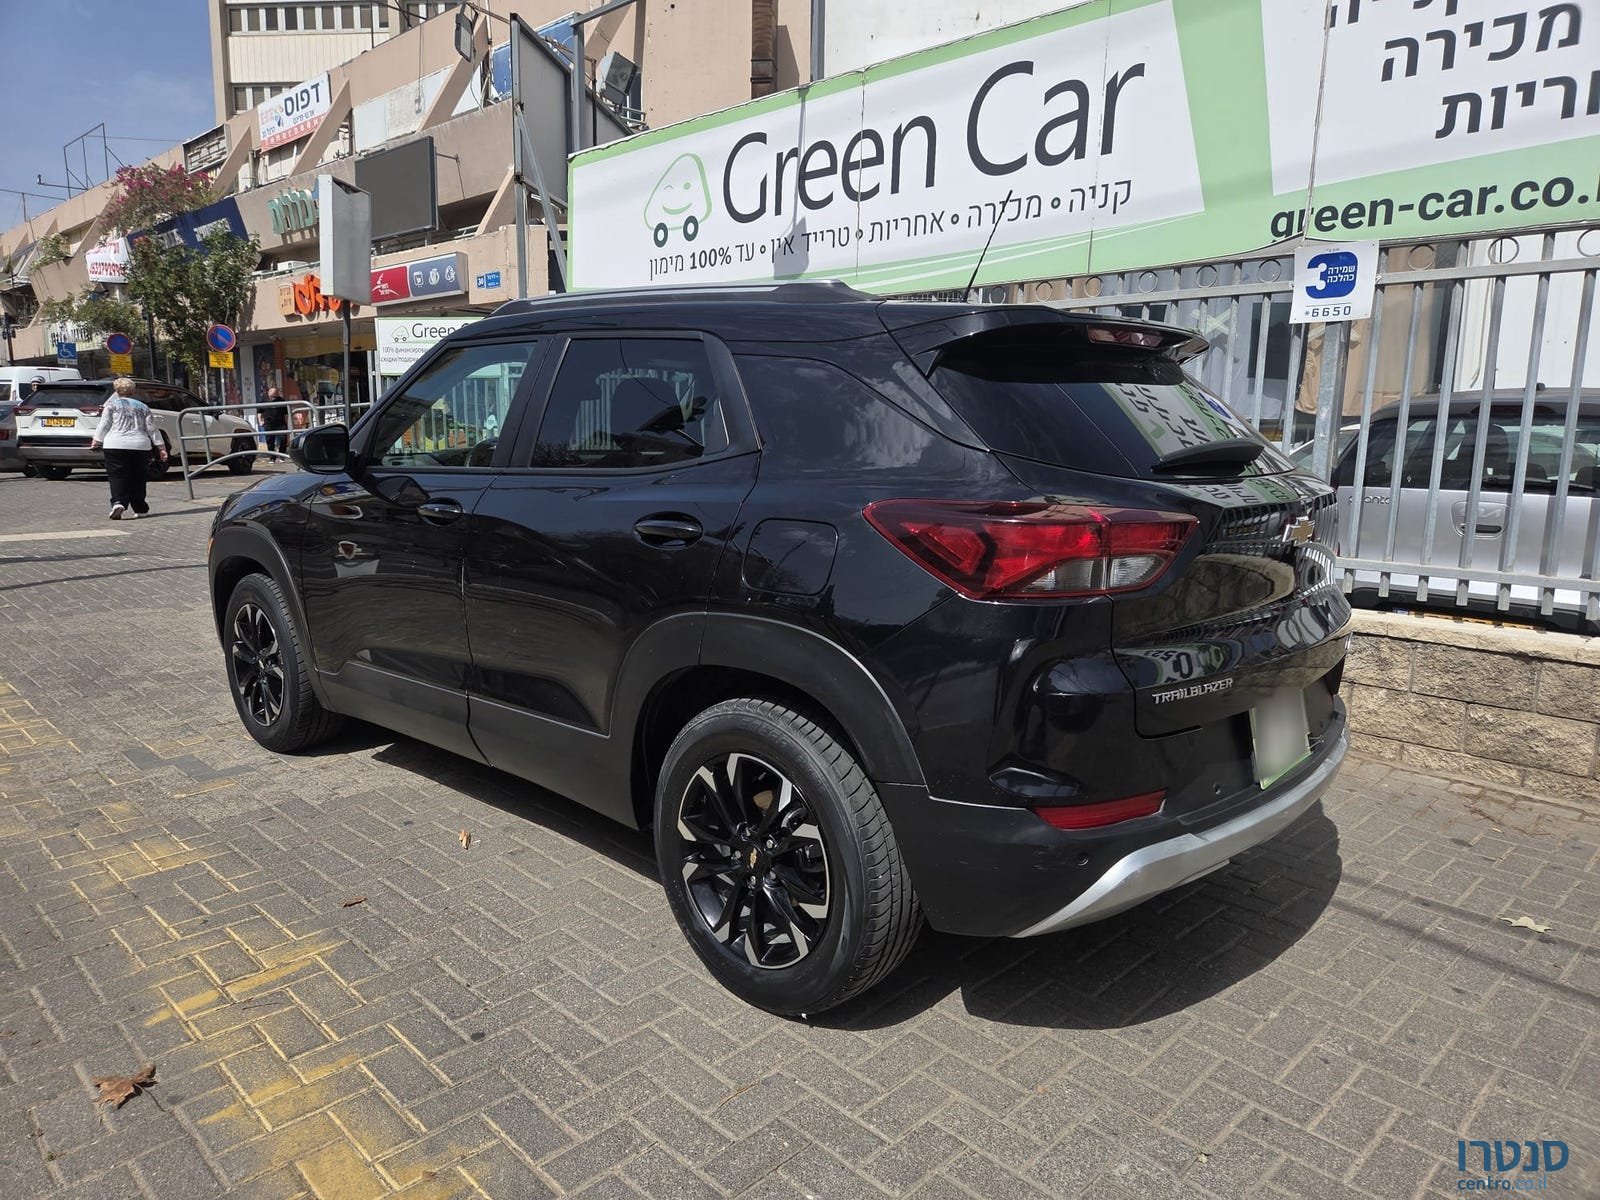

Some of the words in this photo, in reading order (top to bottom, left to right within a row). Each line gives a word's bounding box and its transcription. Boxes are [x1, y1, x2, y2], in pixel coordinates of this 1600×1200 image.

[1381, 2, 1583, 82] מכירה
[284, 82, 320, 117] דפוס
[723, 115, 937, 224] Green
[966, 60, 1146, 177] Car
[967, 194, 1042, 229] מכירה
[1068, 179, 1132, 215] קניה
[1270, 172, 1600, 239] green-car.co.
[801, 226, 850, 252] טרייד
[868, 210, 945, 243] אחריות
[689, 247, 732, 270] 100%
[735, 242, 755, 263] עד
[770, 235, 796, 264] אין
[649, 254, 684, 281] מימון
[1326, 274, 1355, 283] כהלכה
[1327, 265, 1356, 275] שמירה
[1152, 677, 1233, 704] TRAILBLAZER
